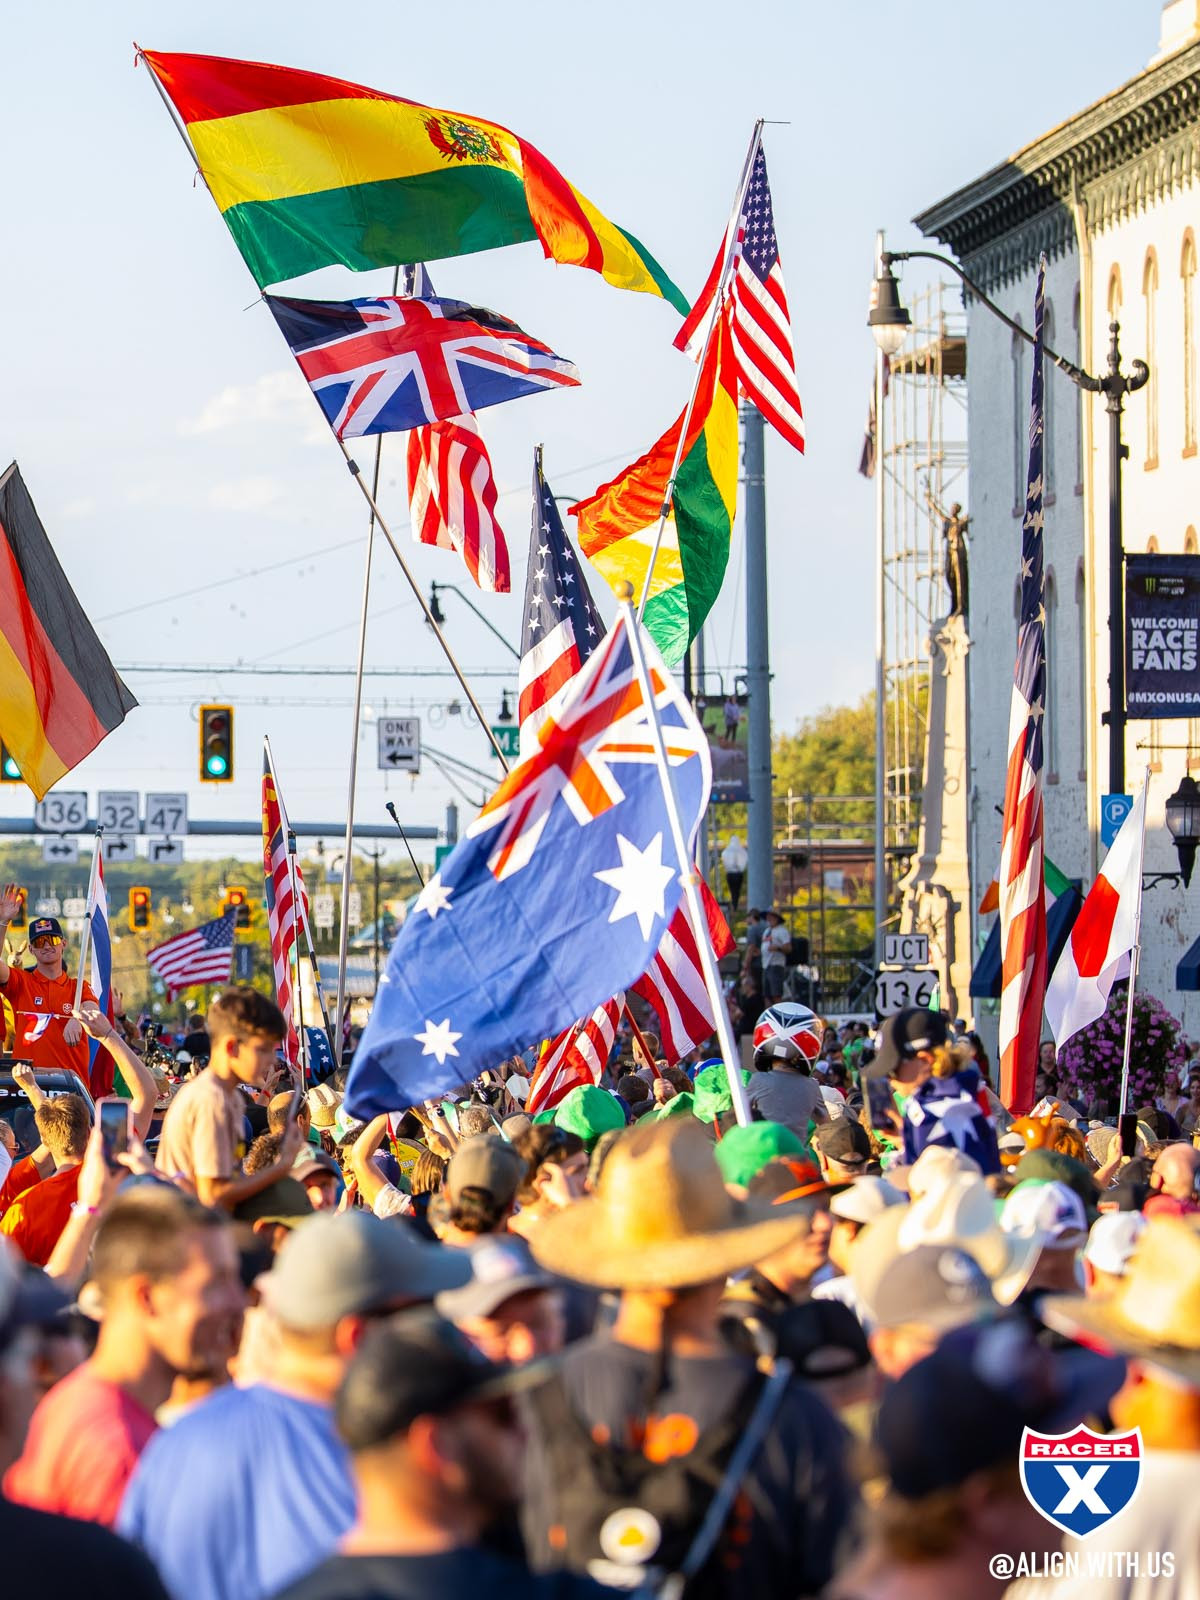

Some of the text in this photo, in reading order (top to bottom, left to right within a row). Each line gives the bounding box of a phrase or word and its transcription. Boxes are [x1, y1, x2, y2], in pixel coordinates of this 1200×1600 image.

[1131, 617, 1199, 629] WELCOME
[1132, 630, 1198, 650] RACE
[1132, 650, 1197, 671] FANS
[385, 722, 412, 734] ONE
[385, 737, 413, 747] WAY
[40, 801, 82, 824] 136
[103, 806, 135, 829] 32
[151, 808, 183, 830] 47
[887, 938, 926, 960] JCT
[880, 980, 931, 1010] 136
